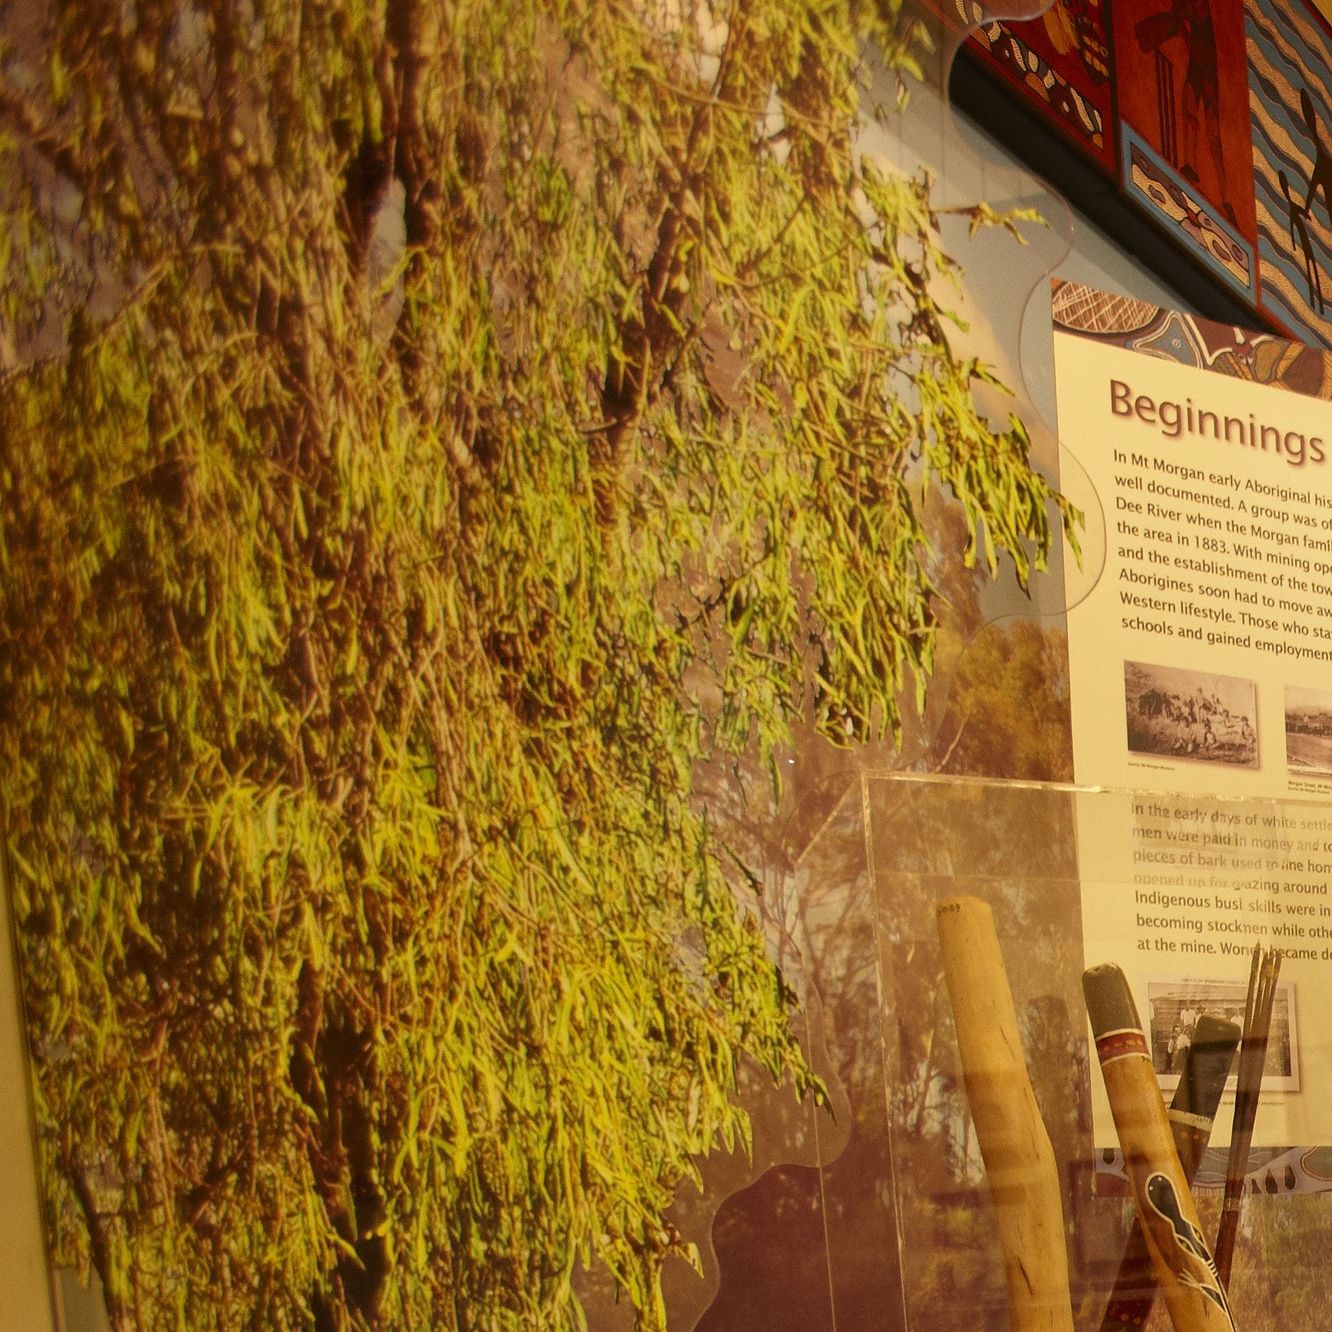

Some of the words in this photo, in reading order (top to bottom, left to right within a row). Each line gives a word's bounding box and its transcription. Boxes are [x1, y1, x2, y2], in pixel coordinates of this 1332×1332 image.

[1109, 379, 1327, 467] Beginnings
[1113, 448, 1126, 463] In
[1131, 452, 1148, 468] Mt
[1153, 457, 1204, 480] Morgan
[1208, 473, 1240, 491] early
[1244, 479, 1310, 503] Aboriginal
[1114, 475, 1142, 490] well
[1147, 480, 1233, 509] documented.
[1237, 499, 1247, 512] A
[1250, 504, 1289, 523] group
[1292, 513, 1317, 527] was
[1115, 496, 1142, 513] Dee
[1147, 502, 1181, 521] River
[1185, 512, 1221, 529] when
[1225, 519, 1246, 535] the
[1250, 524, 1299, 545] Morgan
[1116, 520, 1138, 536] the
[1143, 528, 1172, 543] area
[1177, 531, 1189, 546] in
[1195, 535, 1229, 554] 1883.
[1232, 543, 1261, 560] With
[1266, 551, 1309, 572] mining
